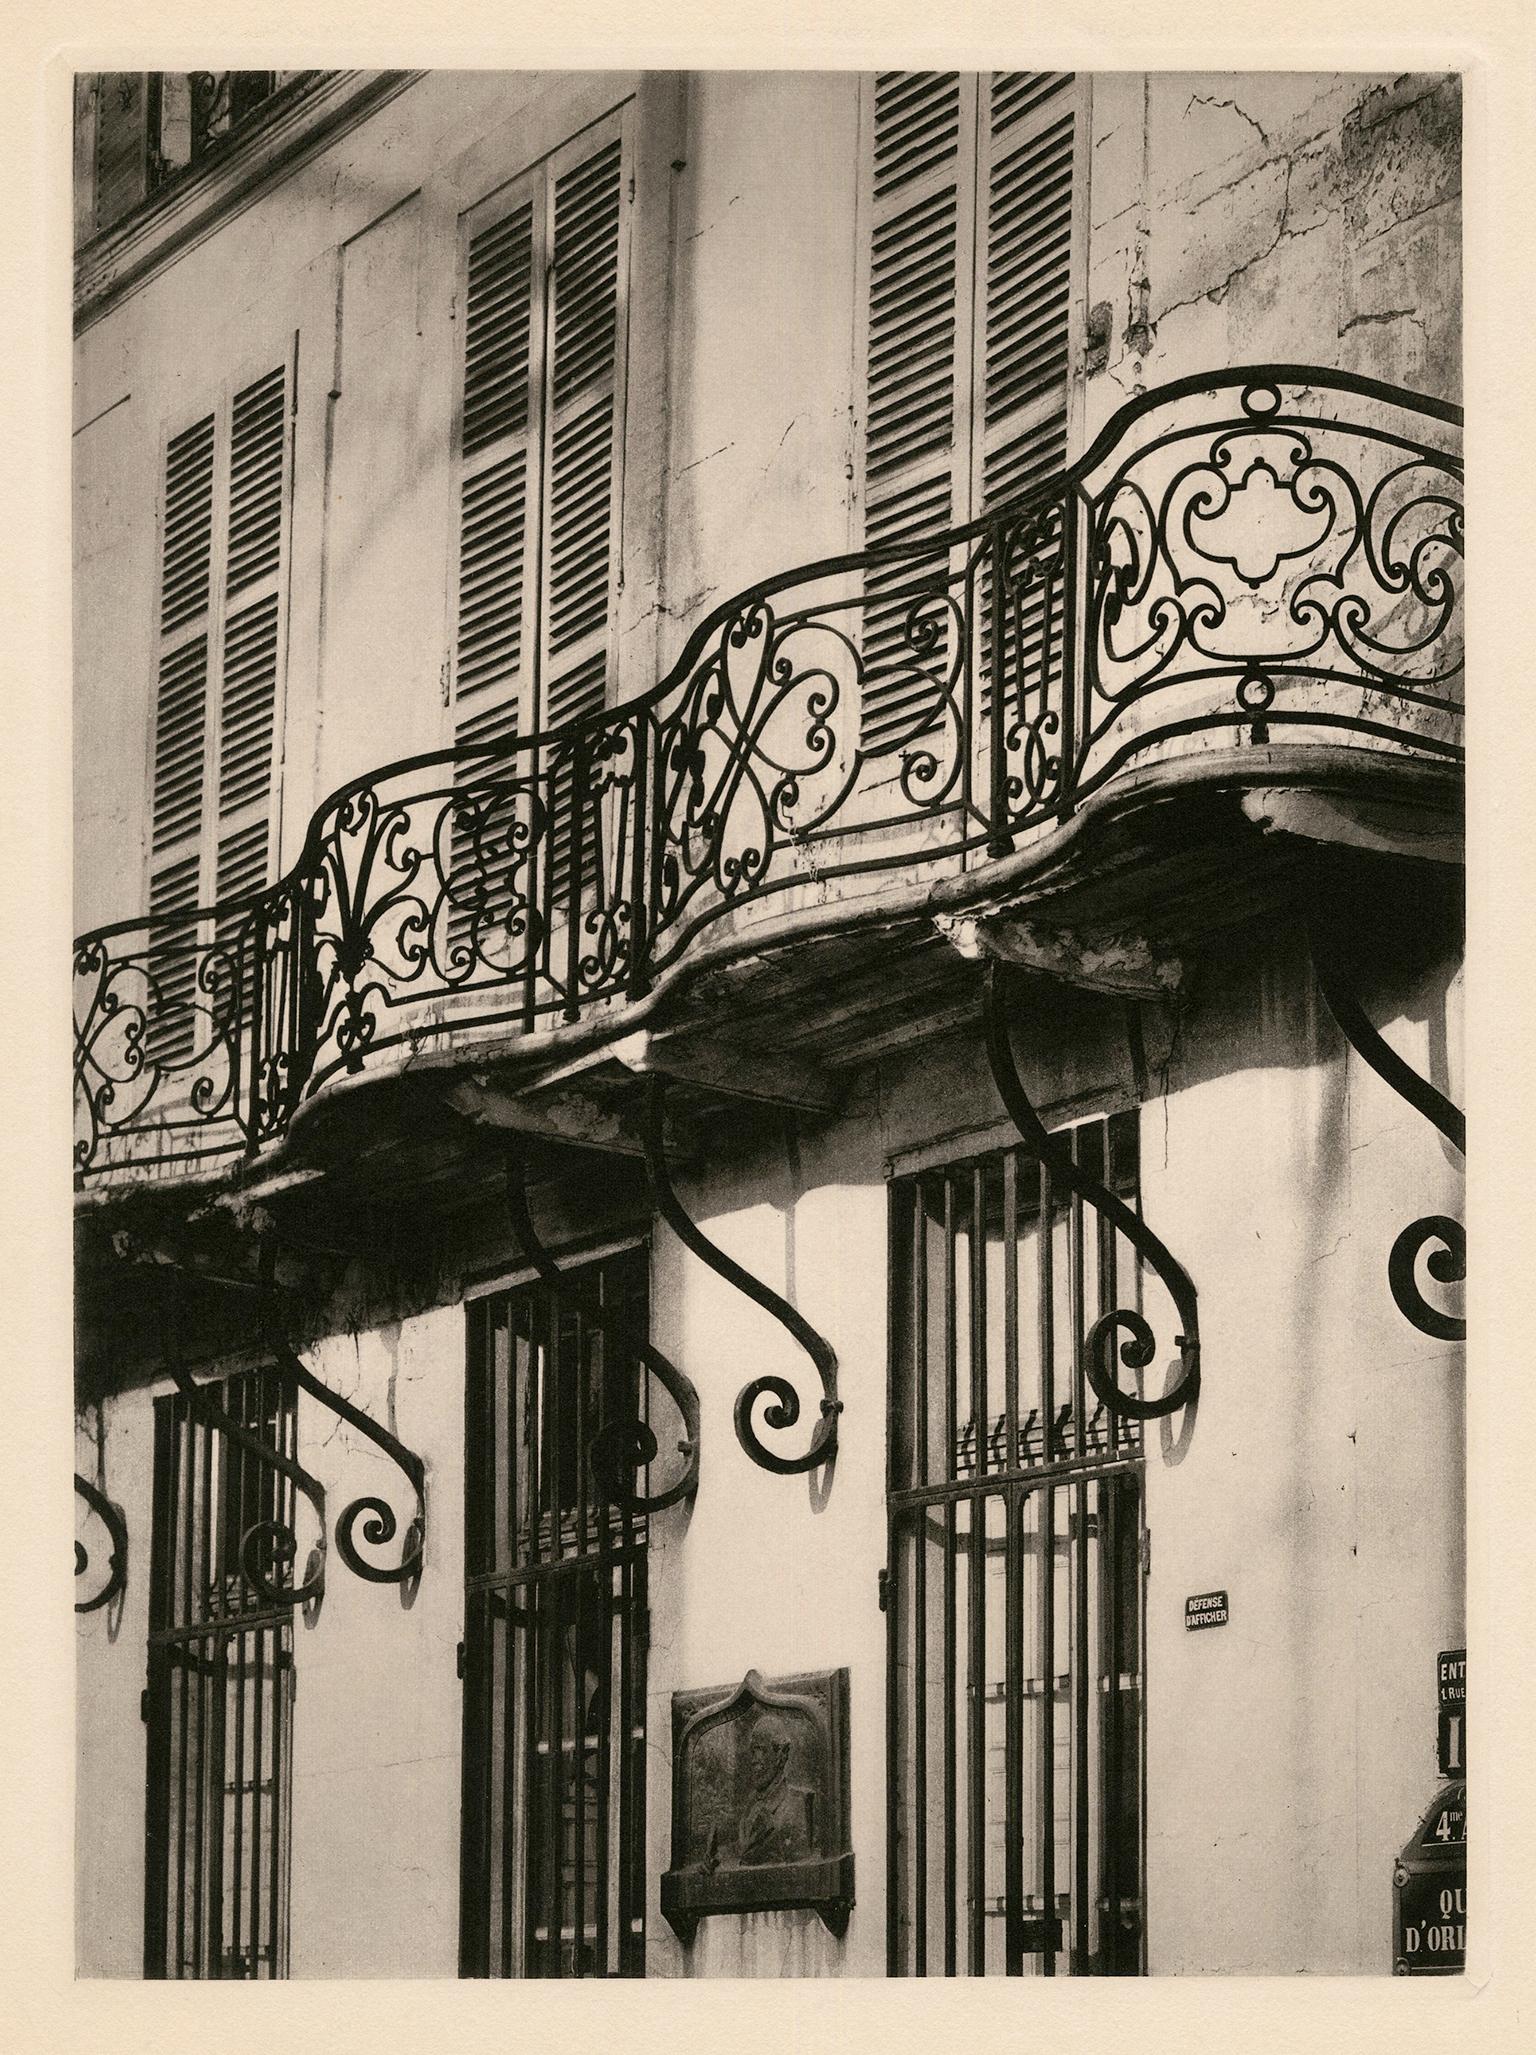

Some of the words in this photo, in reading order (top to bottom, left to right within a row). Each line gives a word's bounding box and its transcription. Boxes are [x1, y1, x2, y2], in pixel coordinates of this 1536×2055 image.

[1188, 1596, 1223, 1611] DÉFENSE
[1186, 1610, 1227, 1626] D'AFFICHER
[1441, 1661, 1466, 1680] ENT
